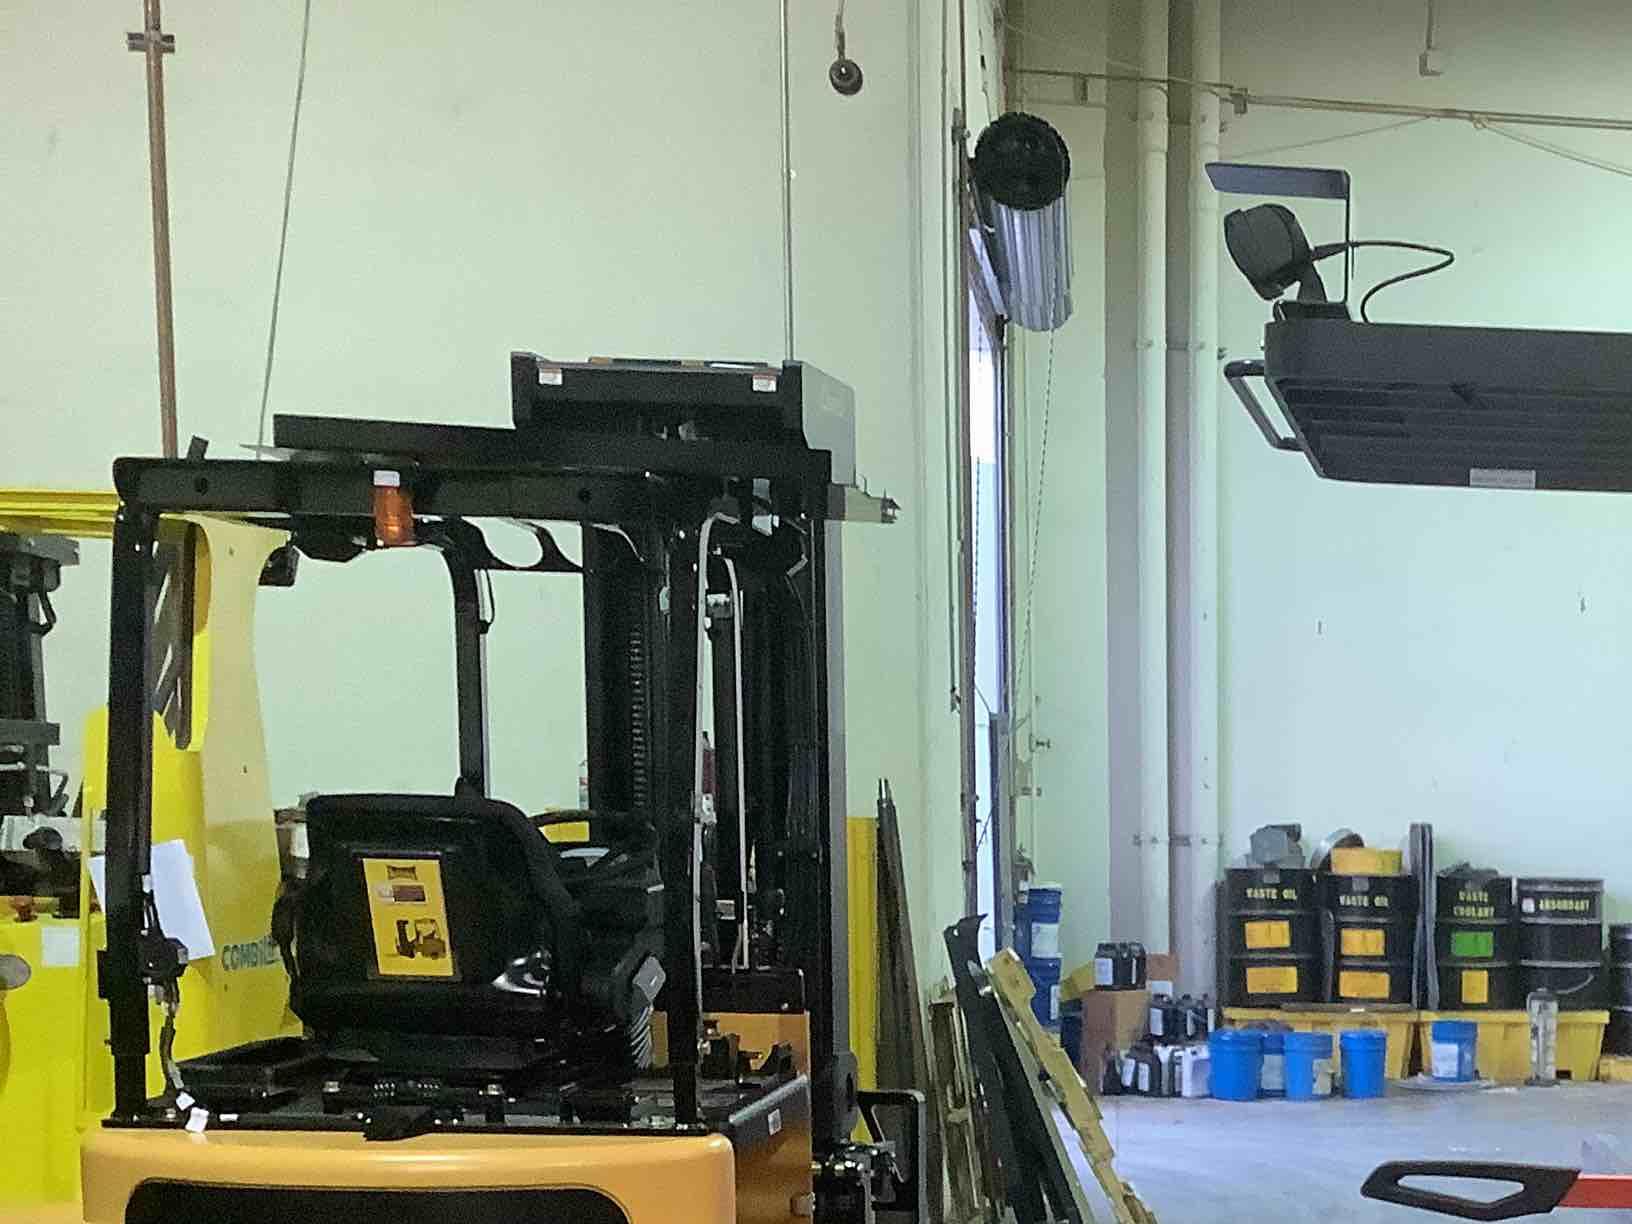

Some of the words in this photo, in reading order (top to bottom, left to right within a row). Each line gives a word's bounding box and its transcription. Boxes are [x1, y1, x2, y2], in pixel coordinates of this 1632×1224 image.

[1246, 887, 1277, 900] WASTE
[1282, 888, 1298, 900] OIL
[1339, 895, 1368, 907] WASTE
[1374, 895, 1389, 907] OIL
